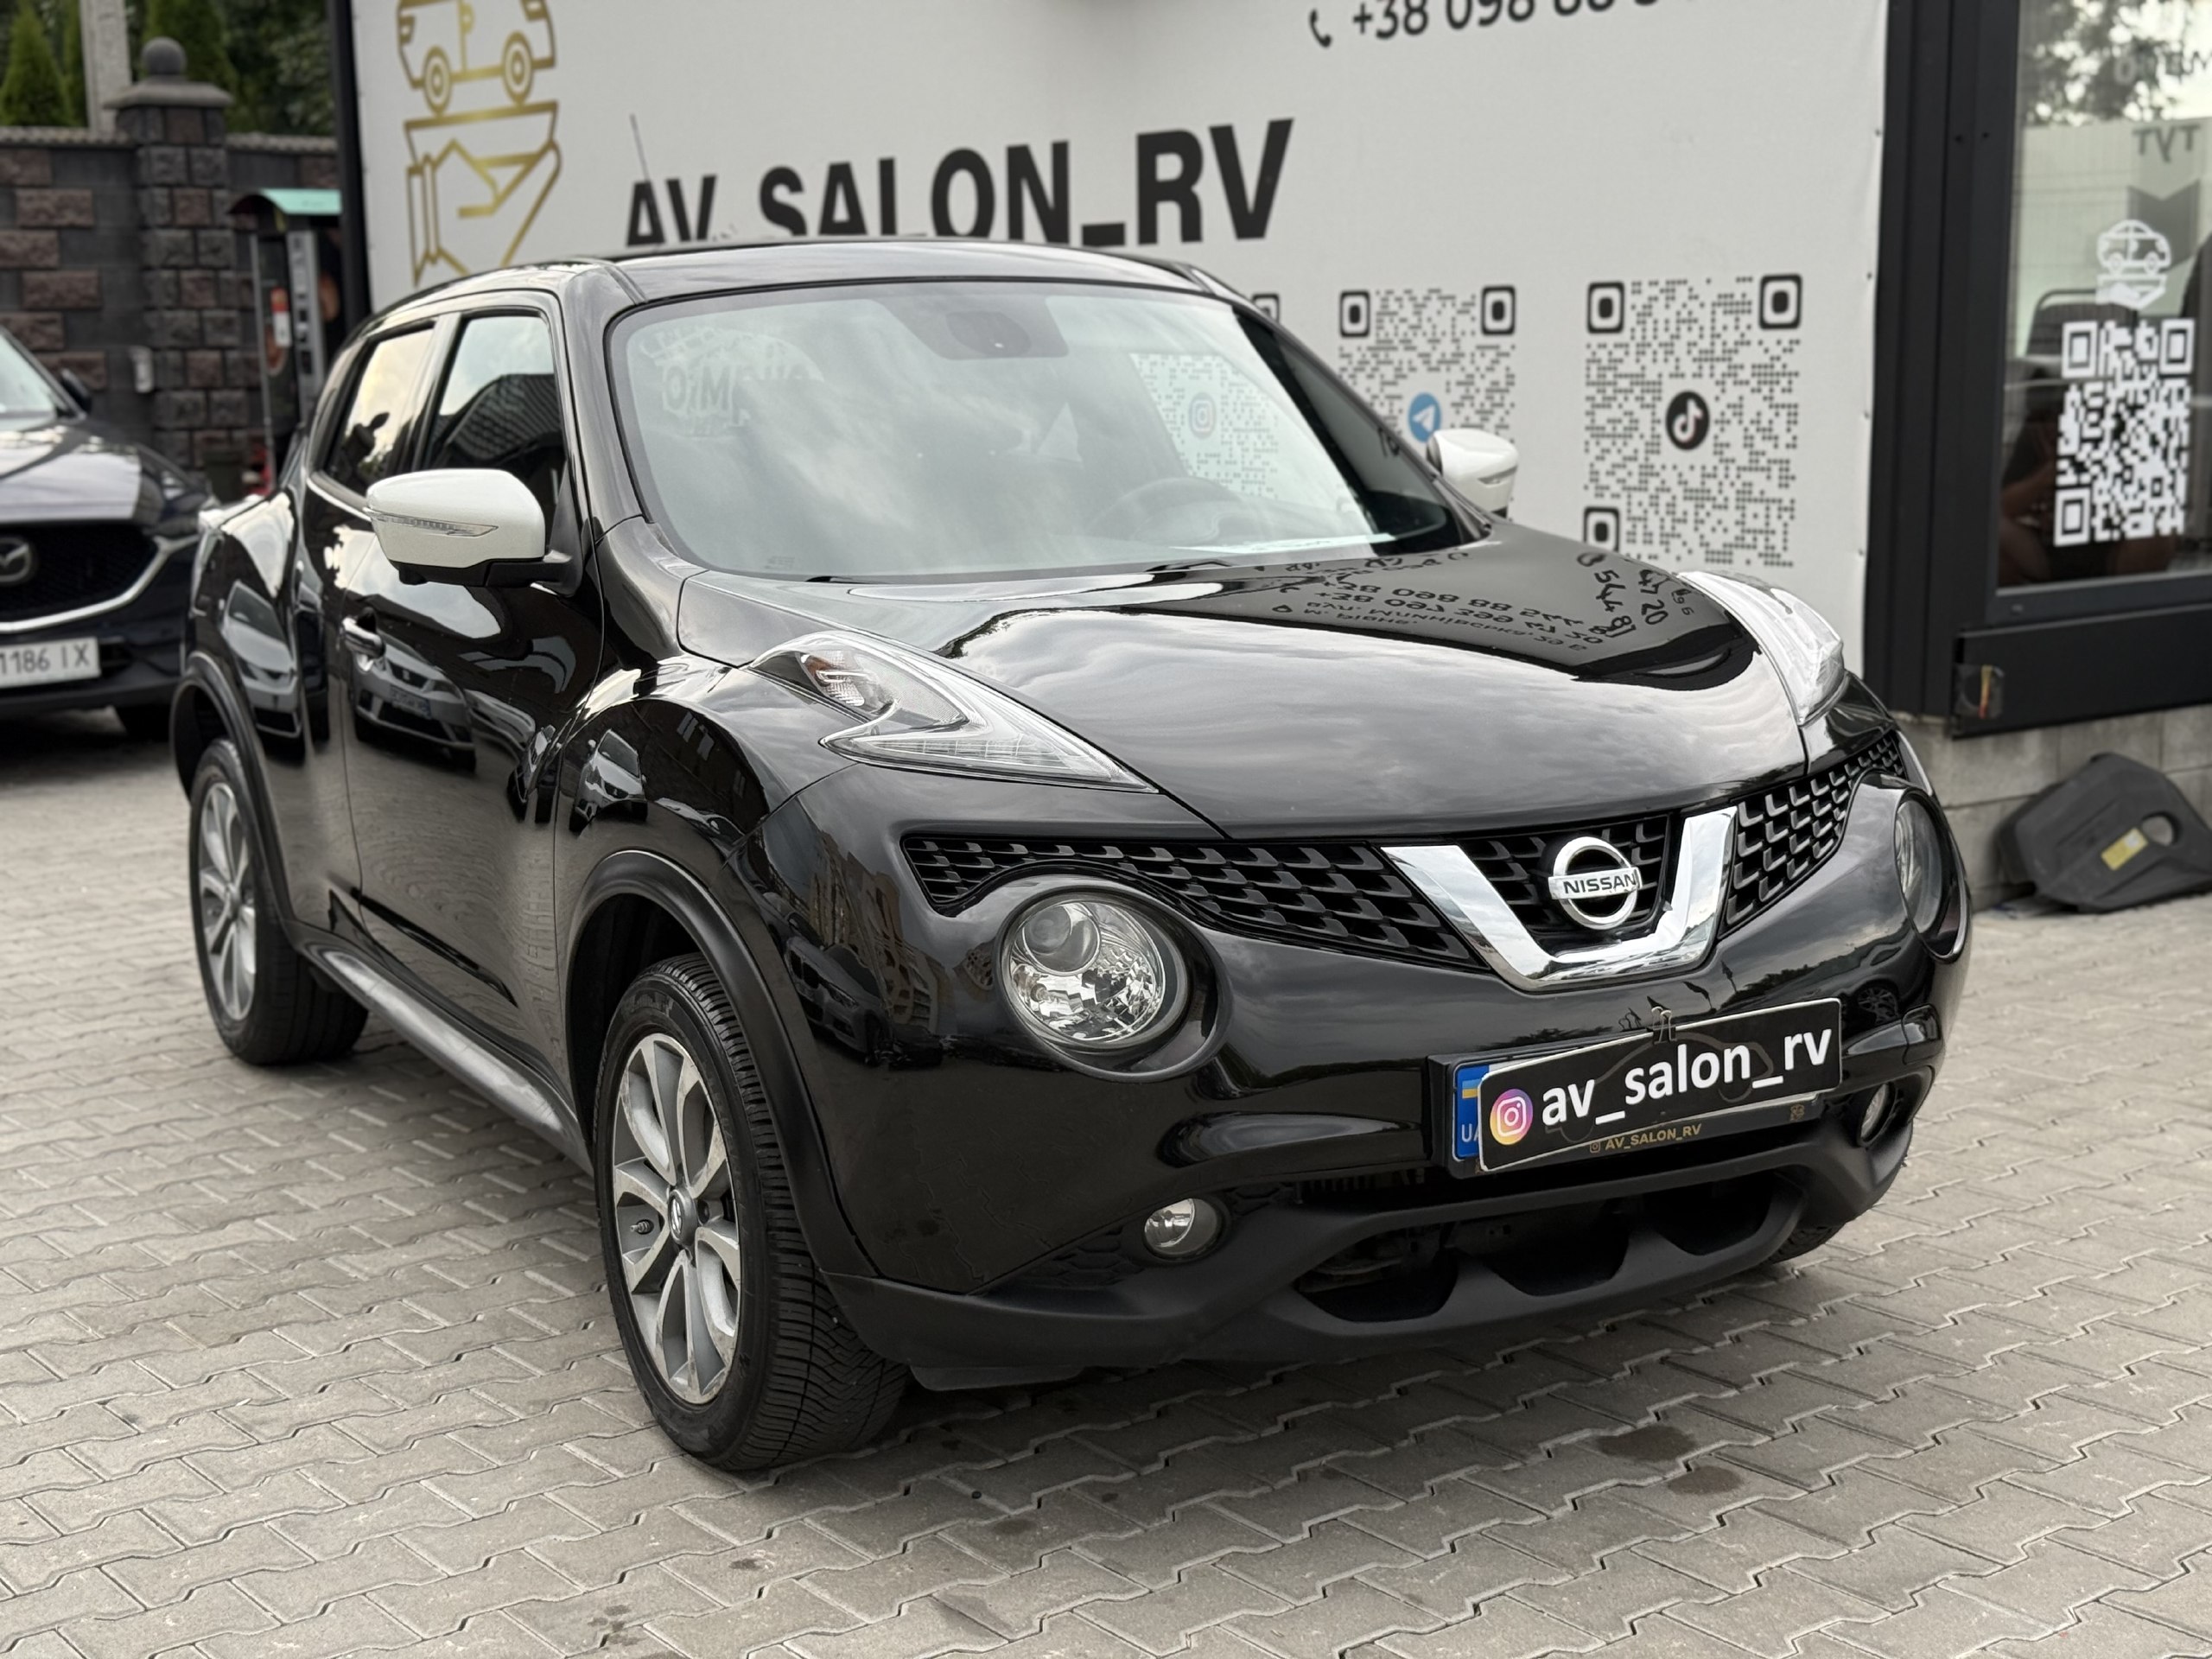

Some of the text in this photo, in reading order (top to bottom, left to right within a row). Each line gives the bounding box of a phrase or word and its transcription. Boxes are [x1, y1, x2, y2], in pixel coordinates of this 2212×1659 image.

[626, 118, 1295, 247] AVSALON_RV
[1562, 872, 1637, 894] NISSAN
[1542, 1028, 1832, 1125] av_salon_rv
[1605, 1123, 1702, 1151] AV_SALON_RV
